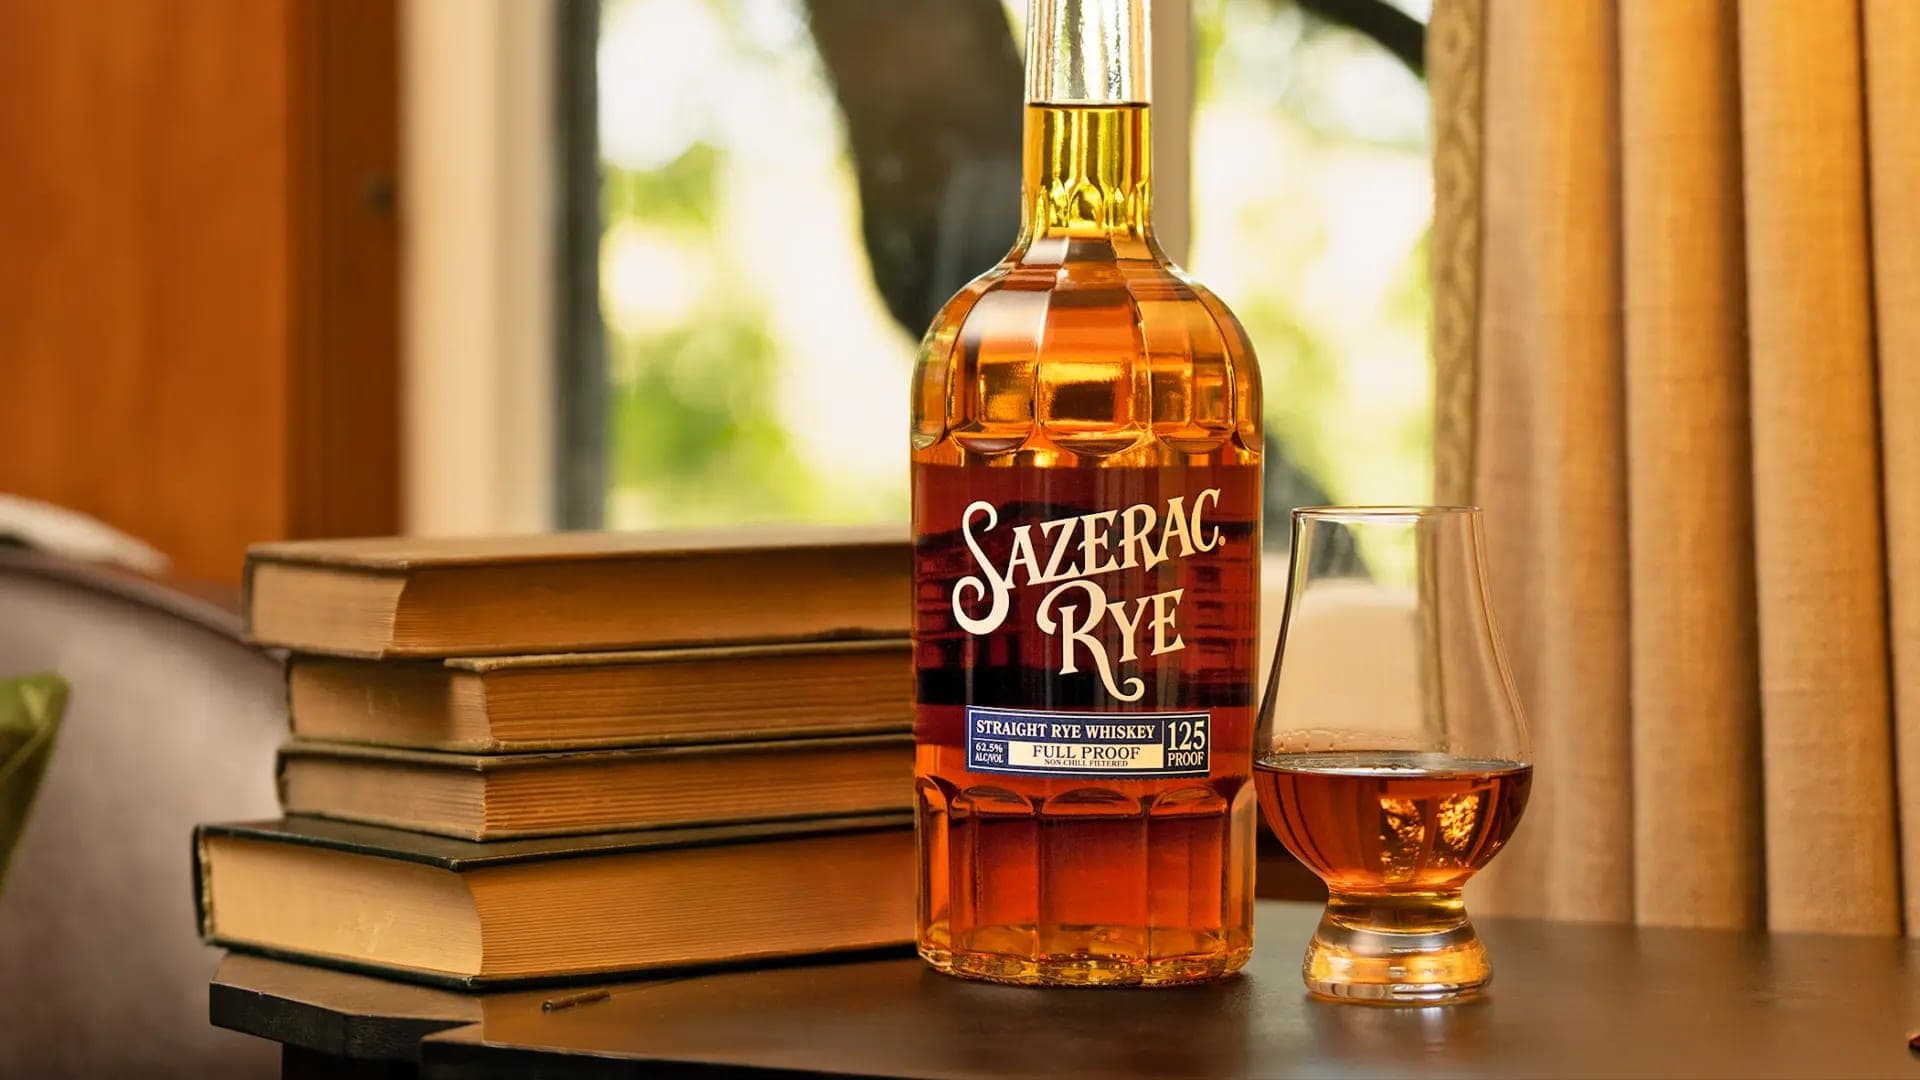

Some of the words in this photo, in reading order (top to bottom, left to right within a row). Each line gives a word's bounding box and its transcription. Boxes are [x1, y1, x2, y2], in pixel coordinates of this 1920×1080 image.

[952, 488, 1221, 635] SAZERAC
[1036, 580, 1186, 702] RYE
[976, 720, 1048, 737] STRAIGHT
[1051, 724, 1081, 738] RYE
[1085, 725, 1156, 739] WHISKEY
[1167, 720, 1206, 751] 125
[975, 742, 1003, 753] 62.5%
[1033, 744, 1076, 759] FULL
[1081, 746, 1141, 760] PROOF
[1089, 759, 1128, 768] FILTERED
[1167, 751, 1205, 767] PROOF
